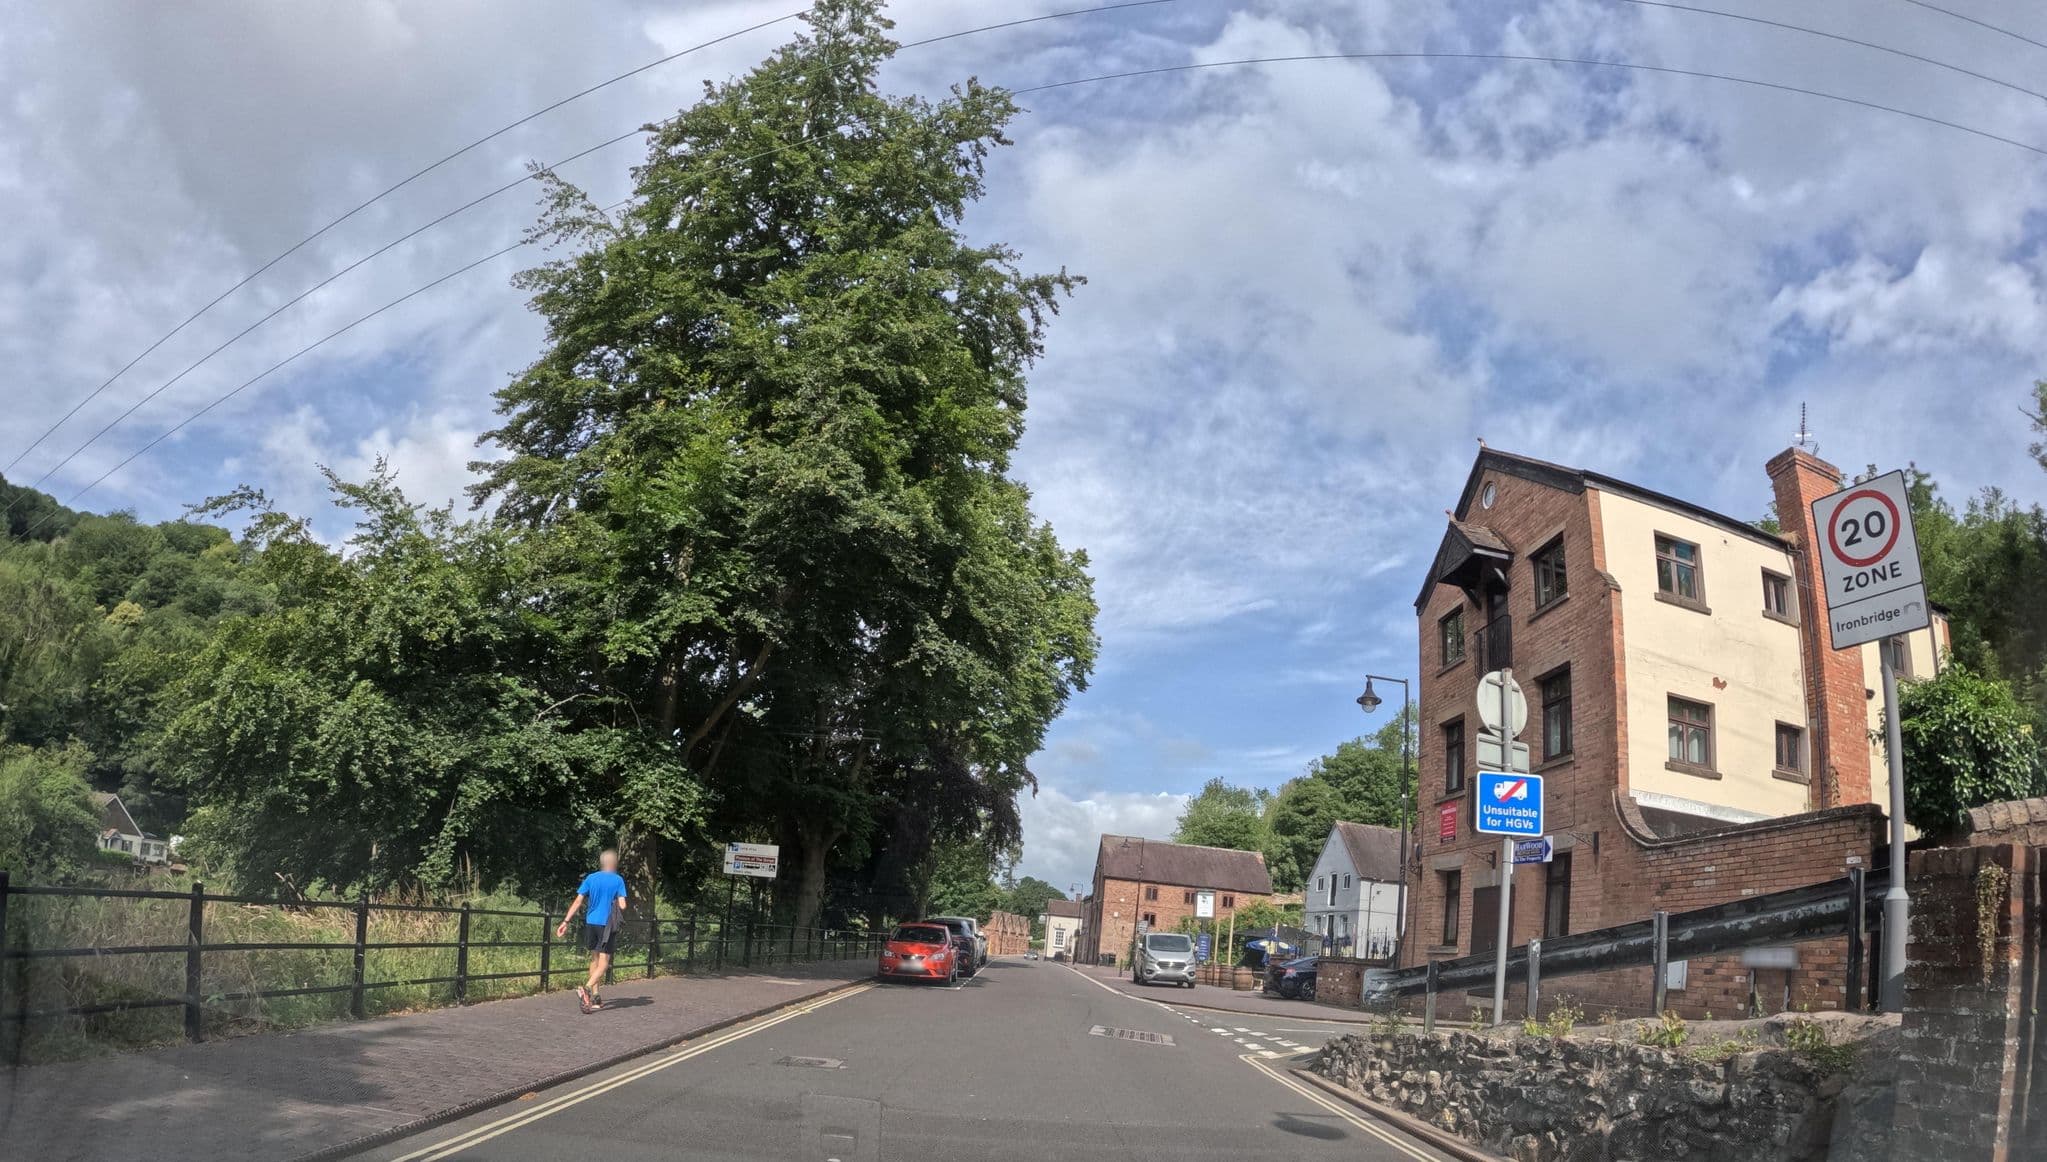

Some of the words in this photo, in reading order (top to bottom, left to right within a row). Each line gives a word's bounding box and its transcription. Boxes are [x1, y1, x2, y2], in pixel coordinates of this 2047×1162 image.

[1841, 510, 1886, 548] 20
[1843, 561, 1902, 593] ZONE
[1836, 606, 1901, 633] Ironbridge
[1483, 804, 1538, 818] Unsuitable
[1487, 816, 1502, 827] for
[1505, 817, 1534, 830] HGVs
